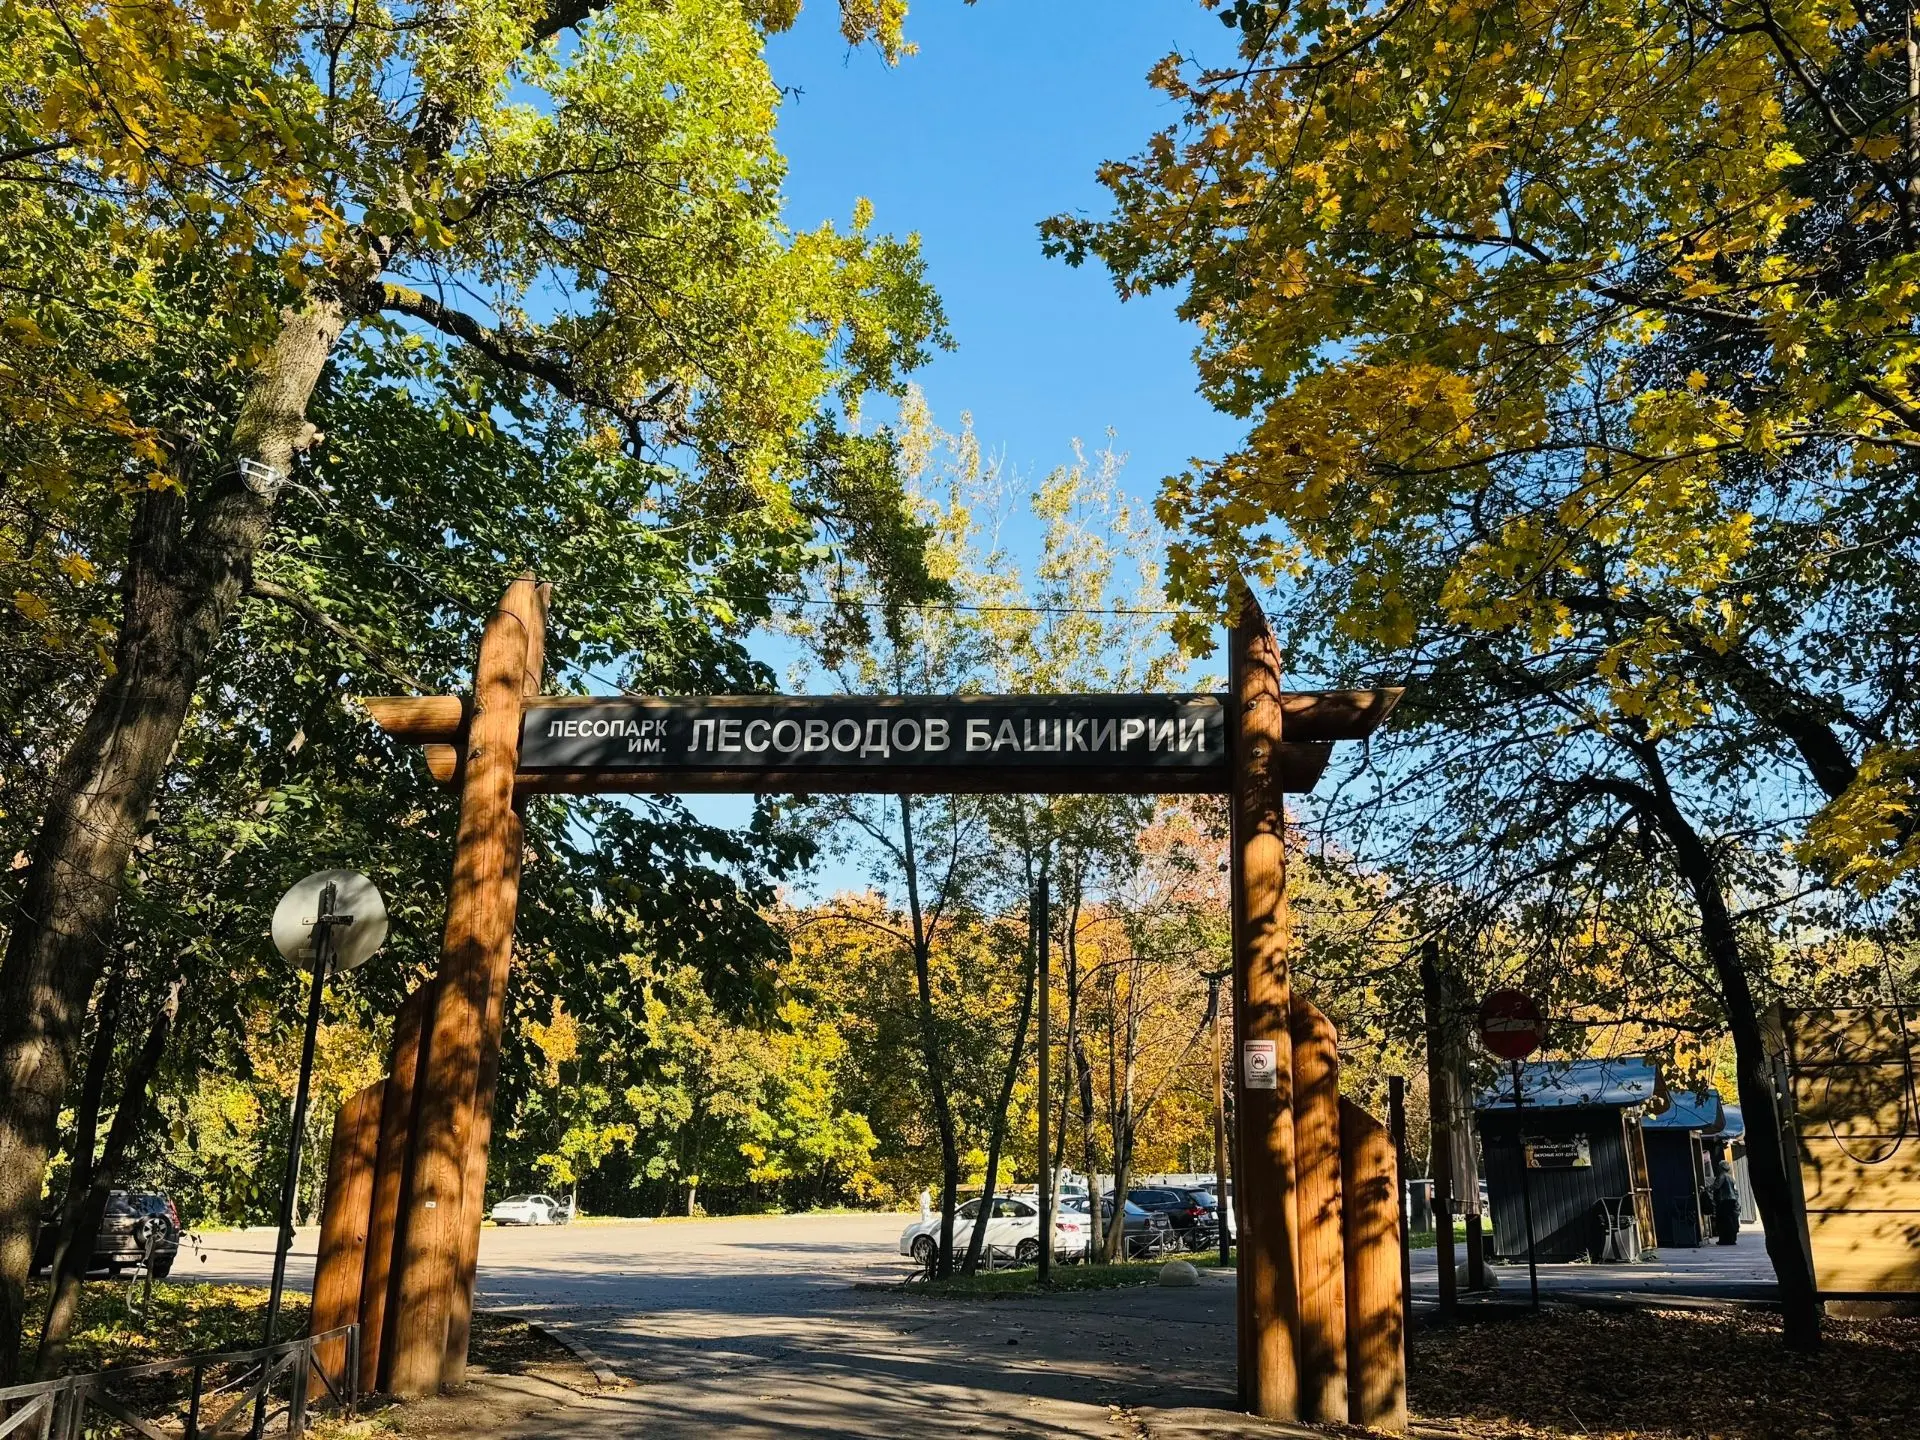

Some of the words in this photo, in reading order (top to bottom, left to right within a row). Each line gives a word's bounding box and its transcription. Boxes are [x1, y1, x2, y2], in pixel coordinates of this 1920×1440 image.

[548, 719, 668, 738] ЛЕСОПАРК
[687, 718, 951, 758] ЛЕСОВОДОВ
[965, 718, 1206, 752] БАШКИРИИ
[628, 739, 667, 753] ИМ.
